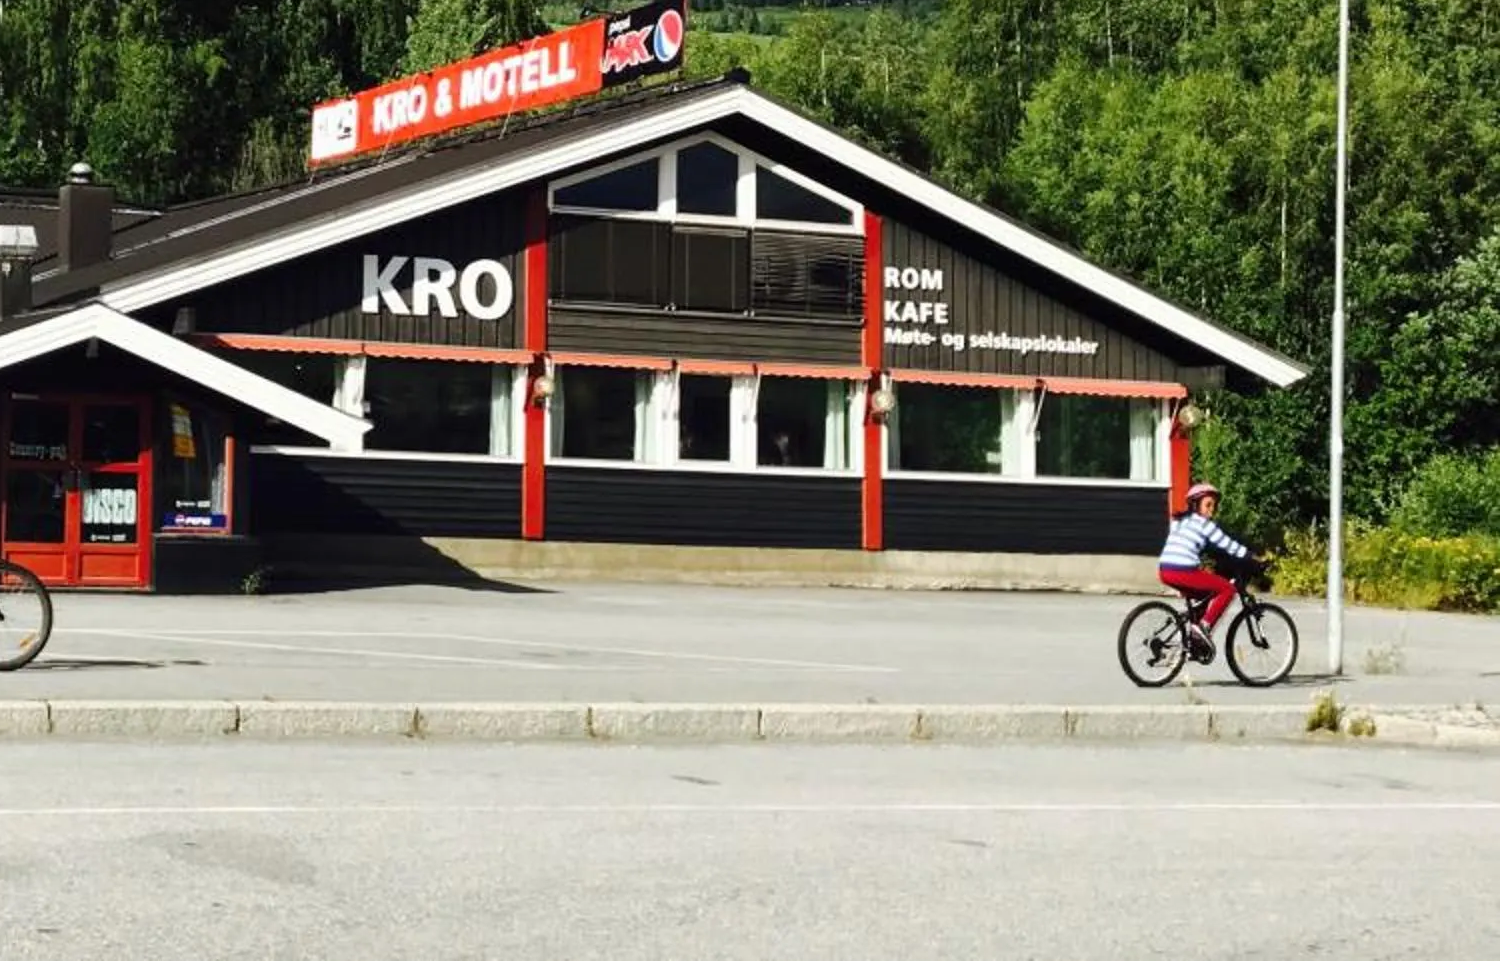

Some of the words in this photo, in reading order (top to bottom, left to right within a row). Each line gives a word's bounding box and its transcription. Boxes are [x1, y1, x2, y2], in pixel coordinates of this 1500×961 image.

[372, 85, 428, 134] KRO
[434, 78, 453, 118] &
[459, 41, 577, 111] MOTELL
[361, 254, 513, 320] KRO
[884, 266, 943, 290] ROM
[884, 300, 949, 324] KAFE
[884, 327, 936, 345] Møte-
[941, 333, 965, 351] og
[969, 330, 1099, 355] selskapslokaler
